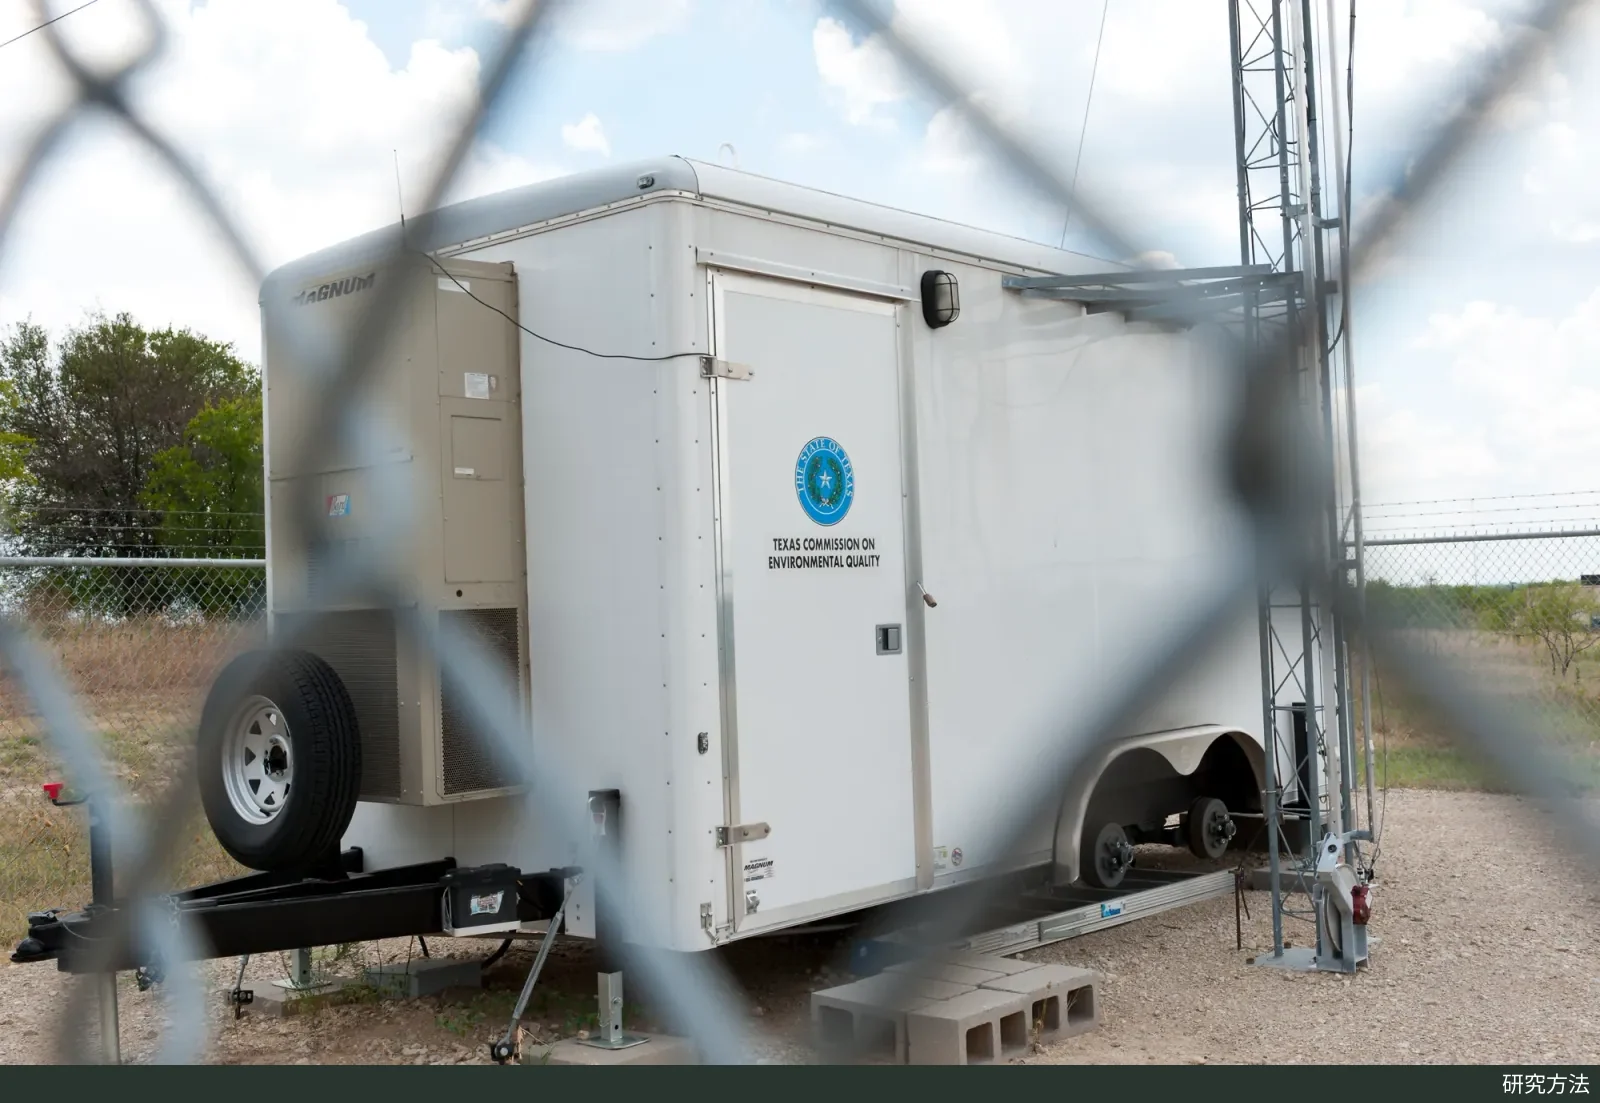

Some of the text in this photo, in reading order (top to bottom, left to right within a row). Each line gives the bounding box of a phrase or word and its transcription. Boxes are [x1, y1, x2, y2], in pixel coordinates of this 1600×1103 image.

[796, 439, 853, 497] THE STATE OF TEXAS
[773, 538, 875, 551] TEXAS COMMISSION ON
[768, 555, 880, 569] ENVIRONMENTAL QUALITY
[744, 860, 773, 871] MAGNUM
